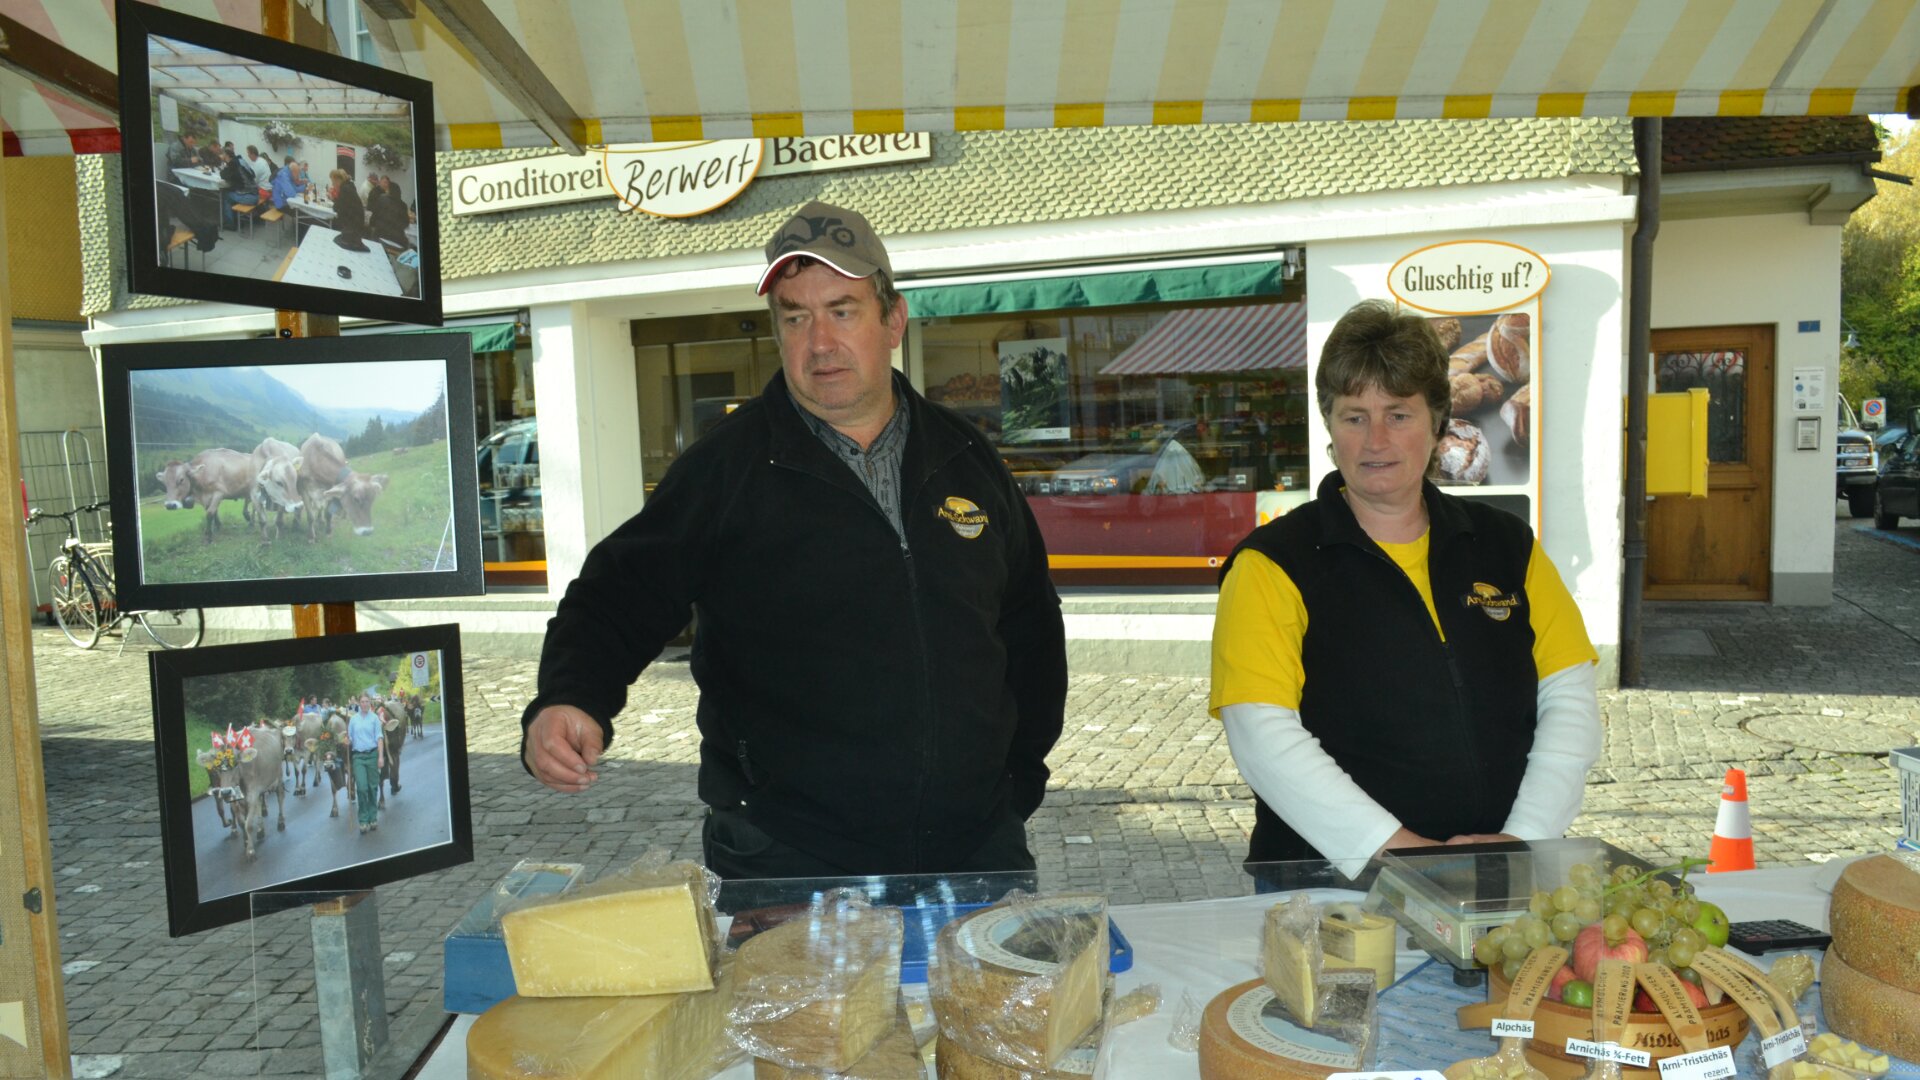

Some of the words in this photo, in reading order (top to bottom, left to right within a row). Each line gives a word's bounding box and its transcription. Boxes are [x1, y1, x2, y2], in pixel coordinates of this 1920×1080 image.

[458, 160, 604, 205] Conditorei
[618, 143, 753, 213] Berwert
[1404, 265, 1494, 293] Gluschtig
[1501, 262, 1533, 288] uf?
[1495, 1022, 1532, 1033] Alpchäs
[1568, 1042, 1611, 1057] Arnichäs
[1662, 1050, 1729, 1071] Arni-Tristächäs
[1703, 1067, 1730, 1079] rezent
